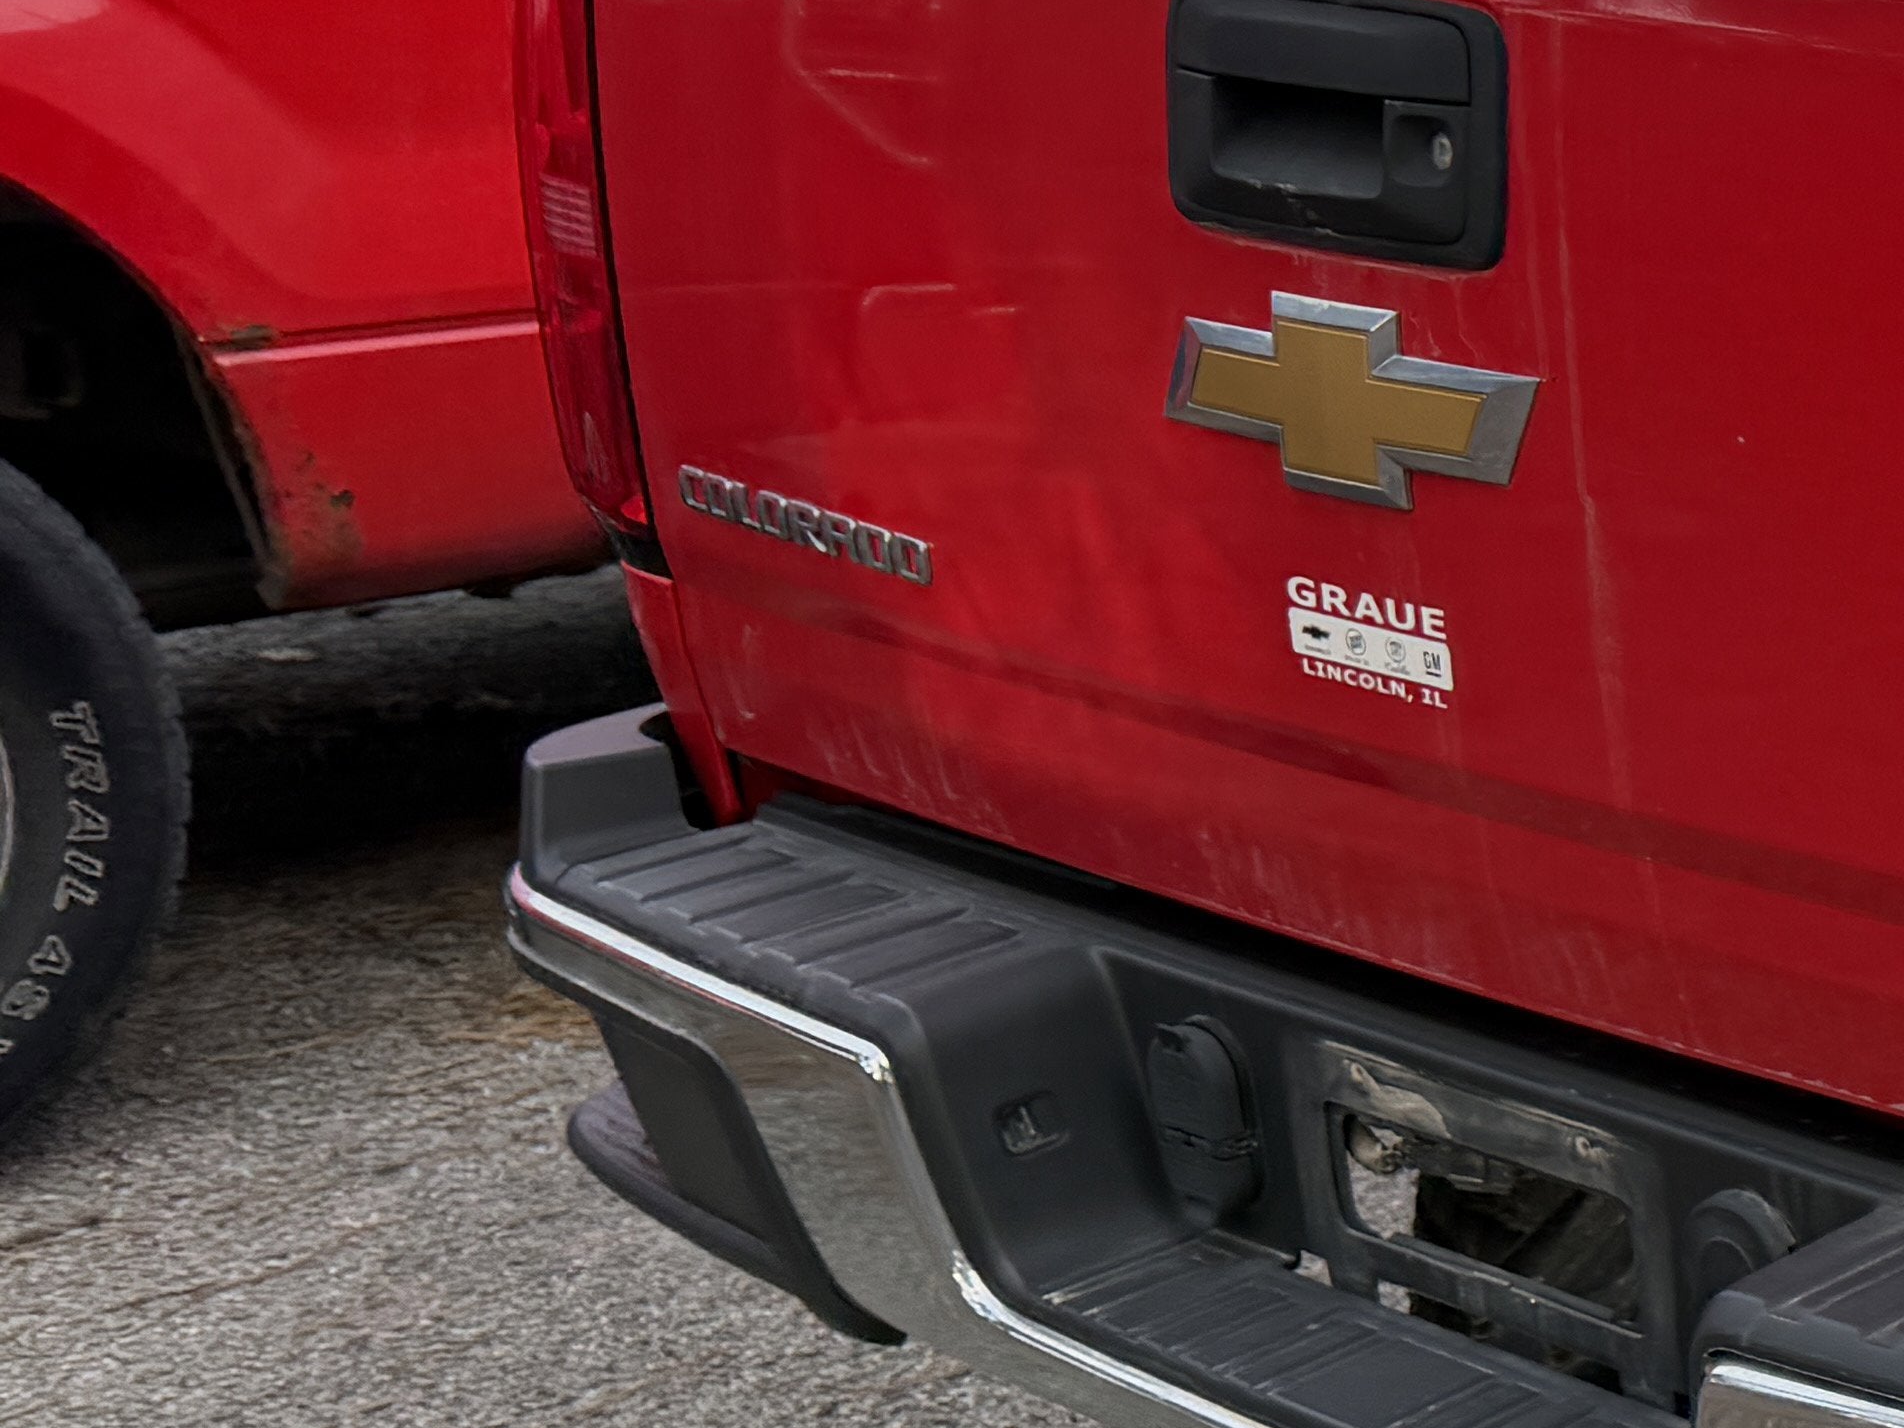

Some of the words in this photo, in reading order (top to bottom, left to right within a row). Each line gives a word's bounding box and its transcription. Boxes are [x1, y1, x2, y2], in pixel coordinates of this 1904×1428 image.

[678, 463, 934, 587] COLORADO
[1286, 575, 1448, 640] GRAUE
[1302, 658, 1414, 703] LINCOLN,
[1421, 688, 1449, 710] IL
[1422, 650, 1442, 673] GM
[49, 700, 111, 913] TRAIL
